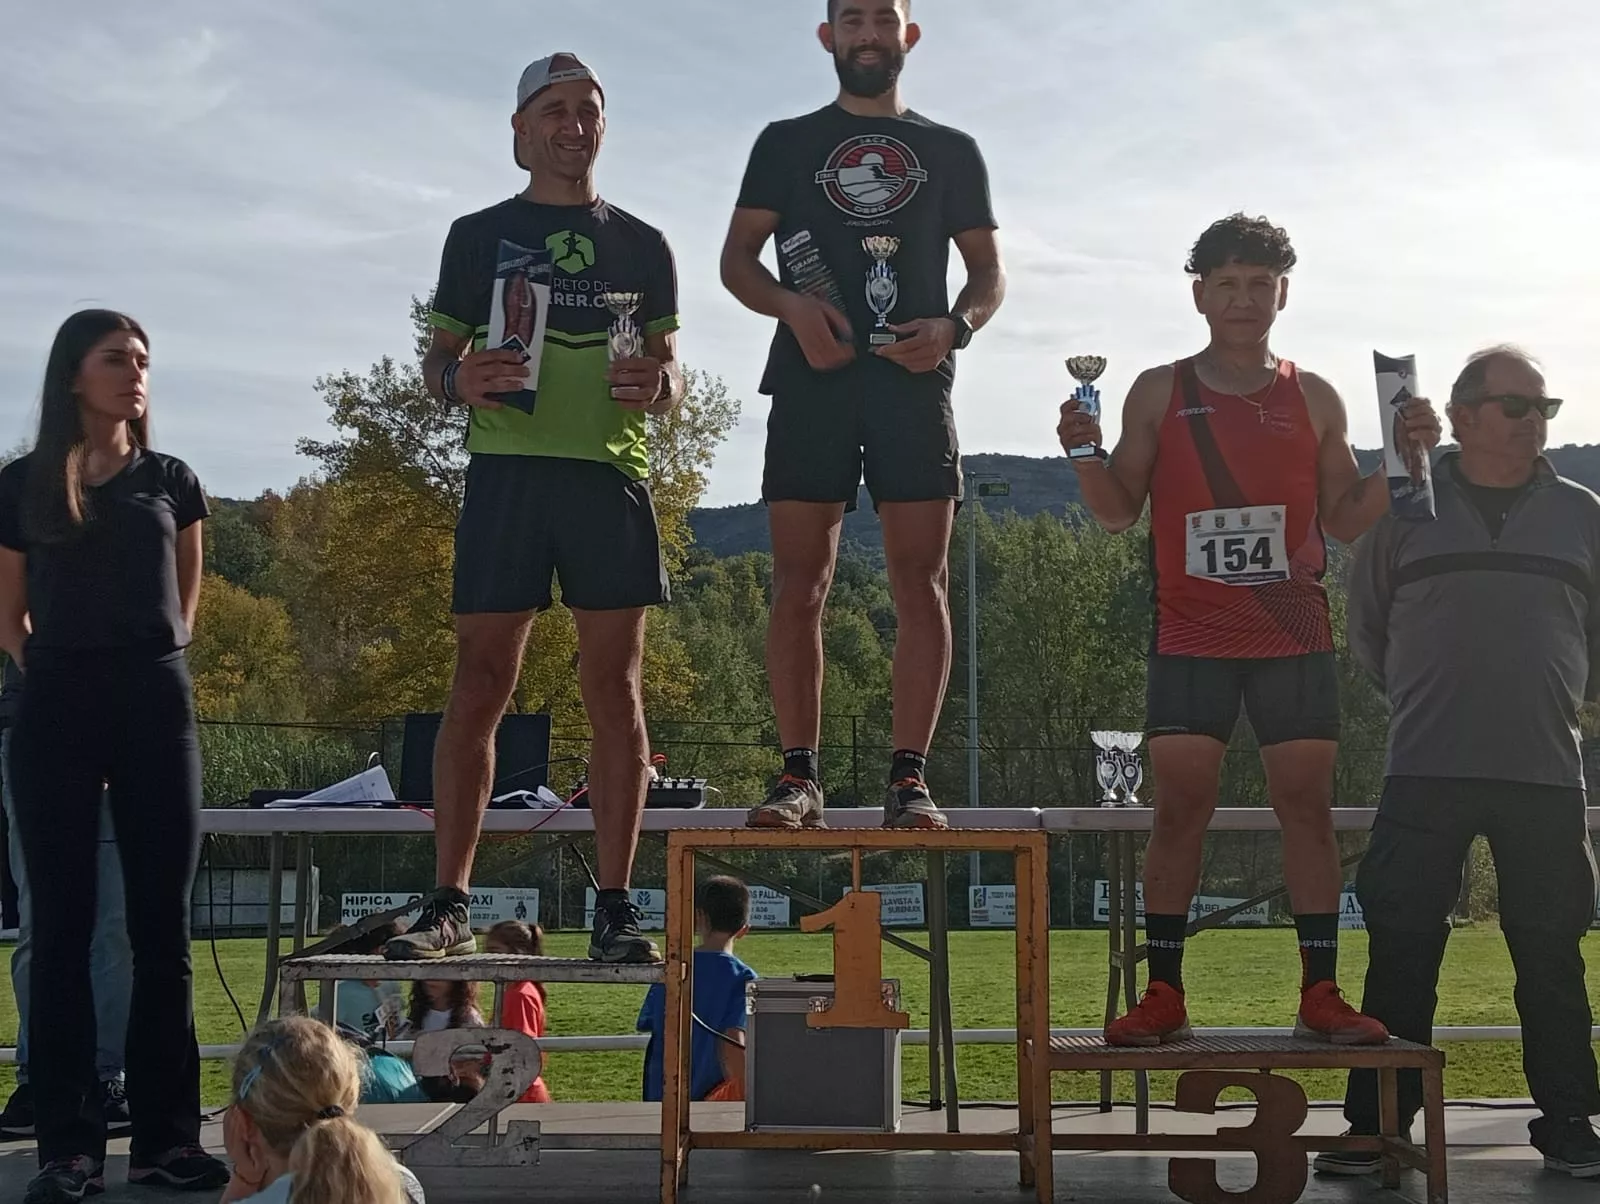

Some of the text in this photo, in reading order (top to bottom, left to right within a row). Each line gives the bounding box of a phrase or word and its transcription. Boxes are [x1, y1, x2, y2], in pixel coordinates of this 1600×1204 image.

[553, 278, 590, 292] RETO
[1200, 537, 1273, 574] 154
[345, 896, 392, 905] HIPICA
[799, 891, 910, 1029] 1
[402, 1028, 541, 1167] 2
[1168, 1070, 1308, 1204] 3
